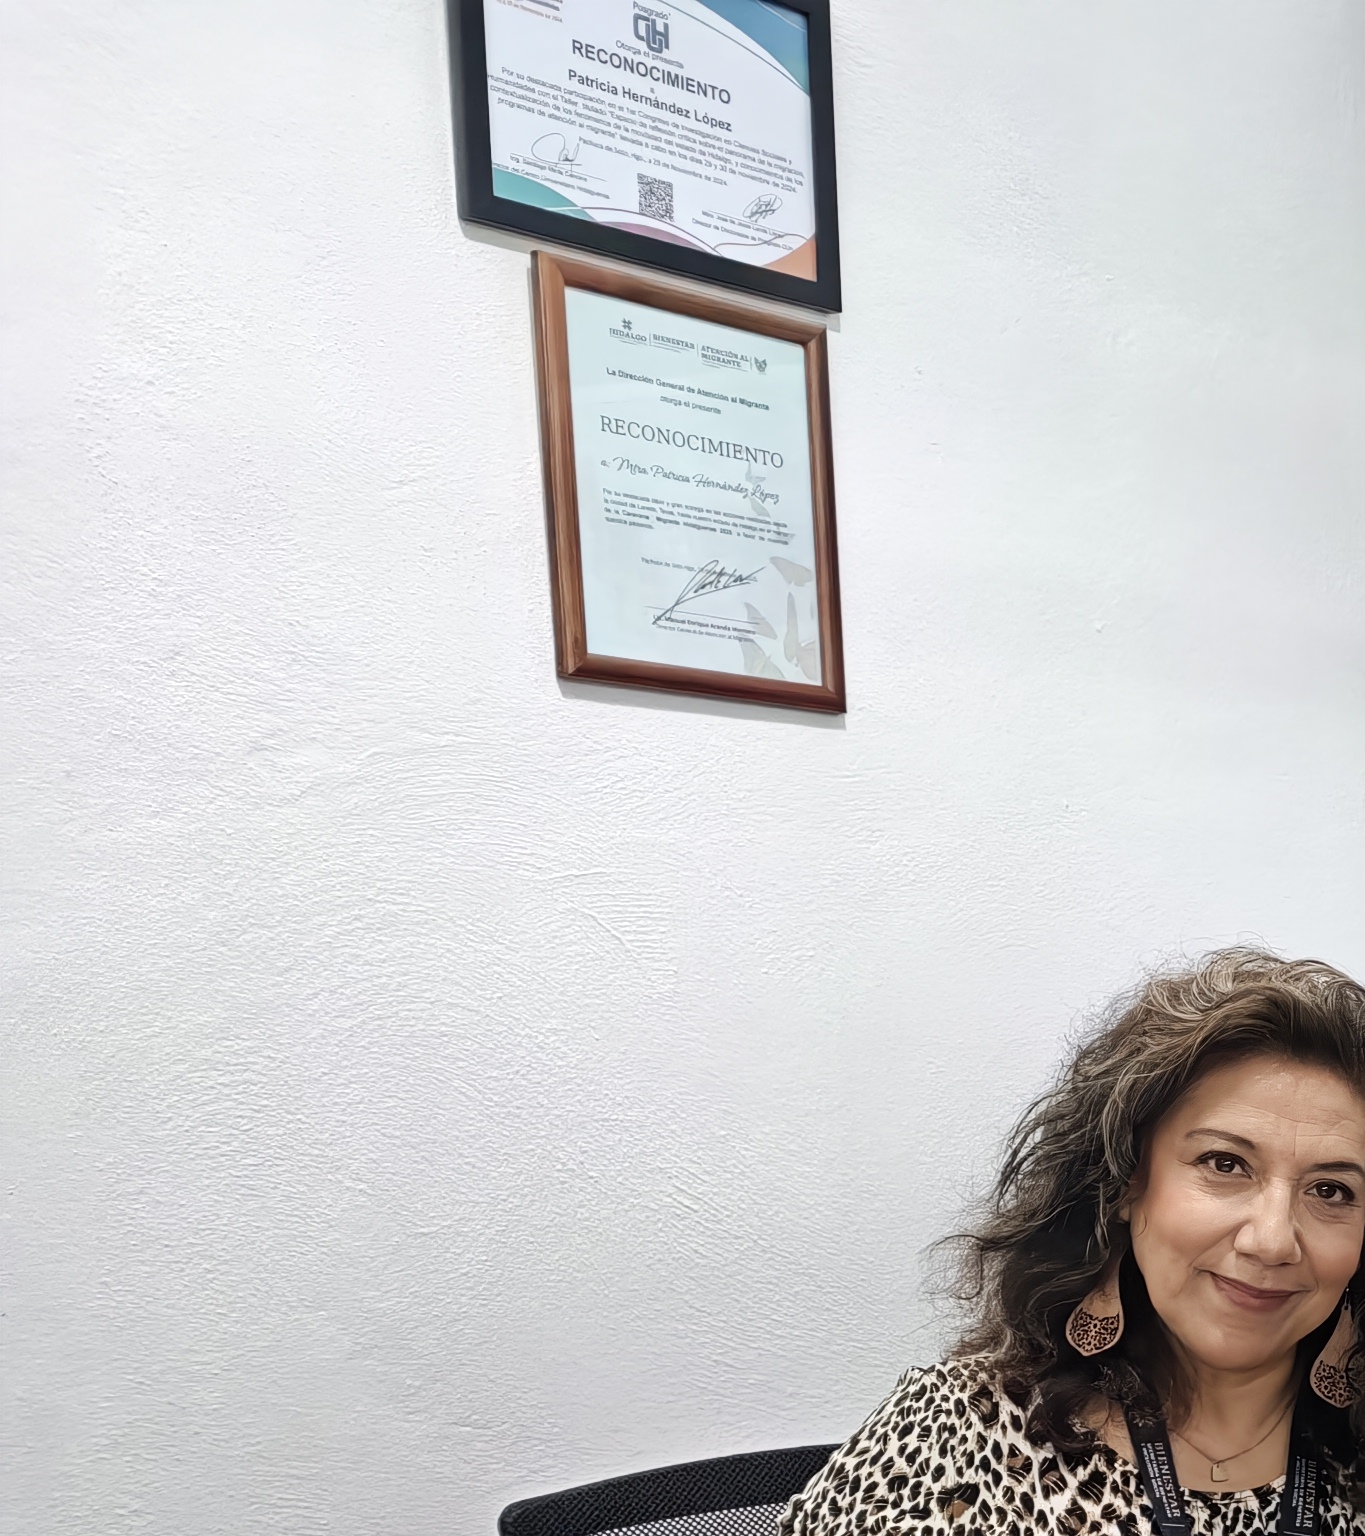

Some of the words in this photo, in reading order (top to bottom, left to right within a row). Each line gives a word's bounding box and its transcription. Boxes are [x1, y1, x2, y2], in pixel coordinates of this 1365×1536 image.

[568, 69, 618, 96] Patricia
[621, 85, 691, 119] Hernández
[694, 109, 732, 132] López
[572, 39, 731, 104] RECONOCIMIENTO
[656, 379, 684, 392] General
[600, 415, 784, 468] RECONOCIMIENTO
[692, 474, 750, 499] Hernández
[1154, 1442, 1181, 1518] BIENESTAR
